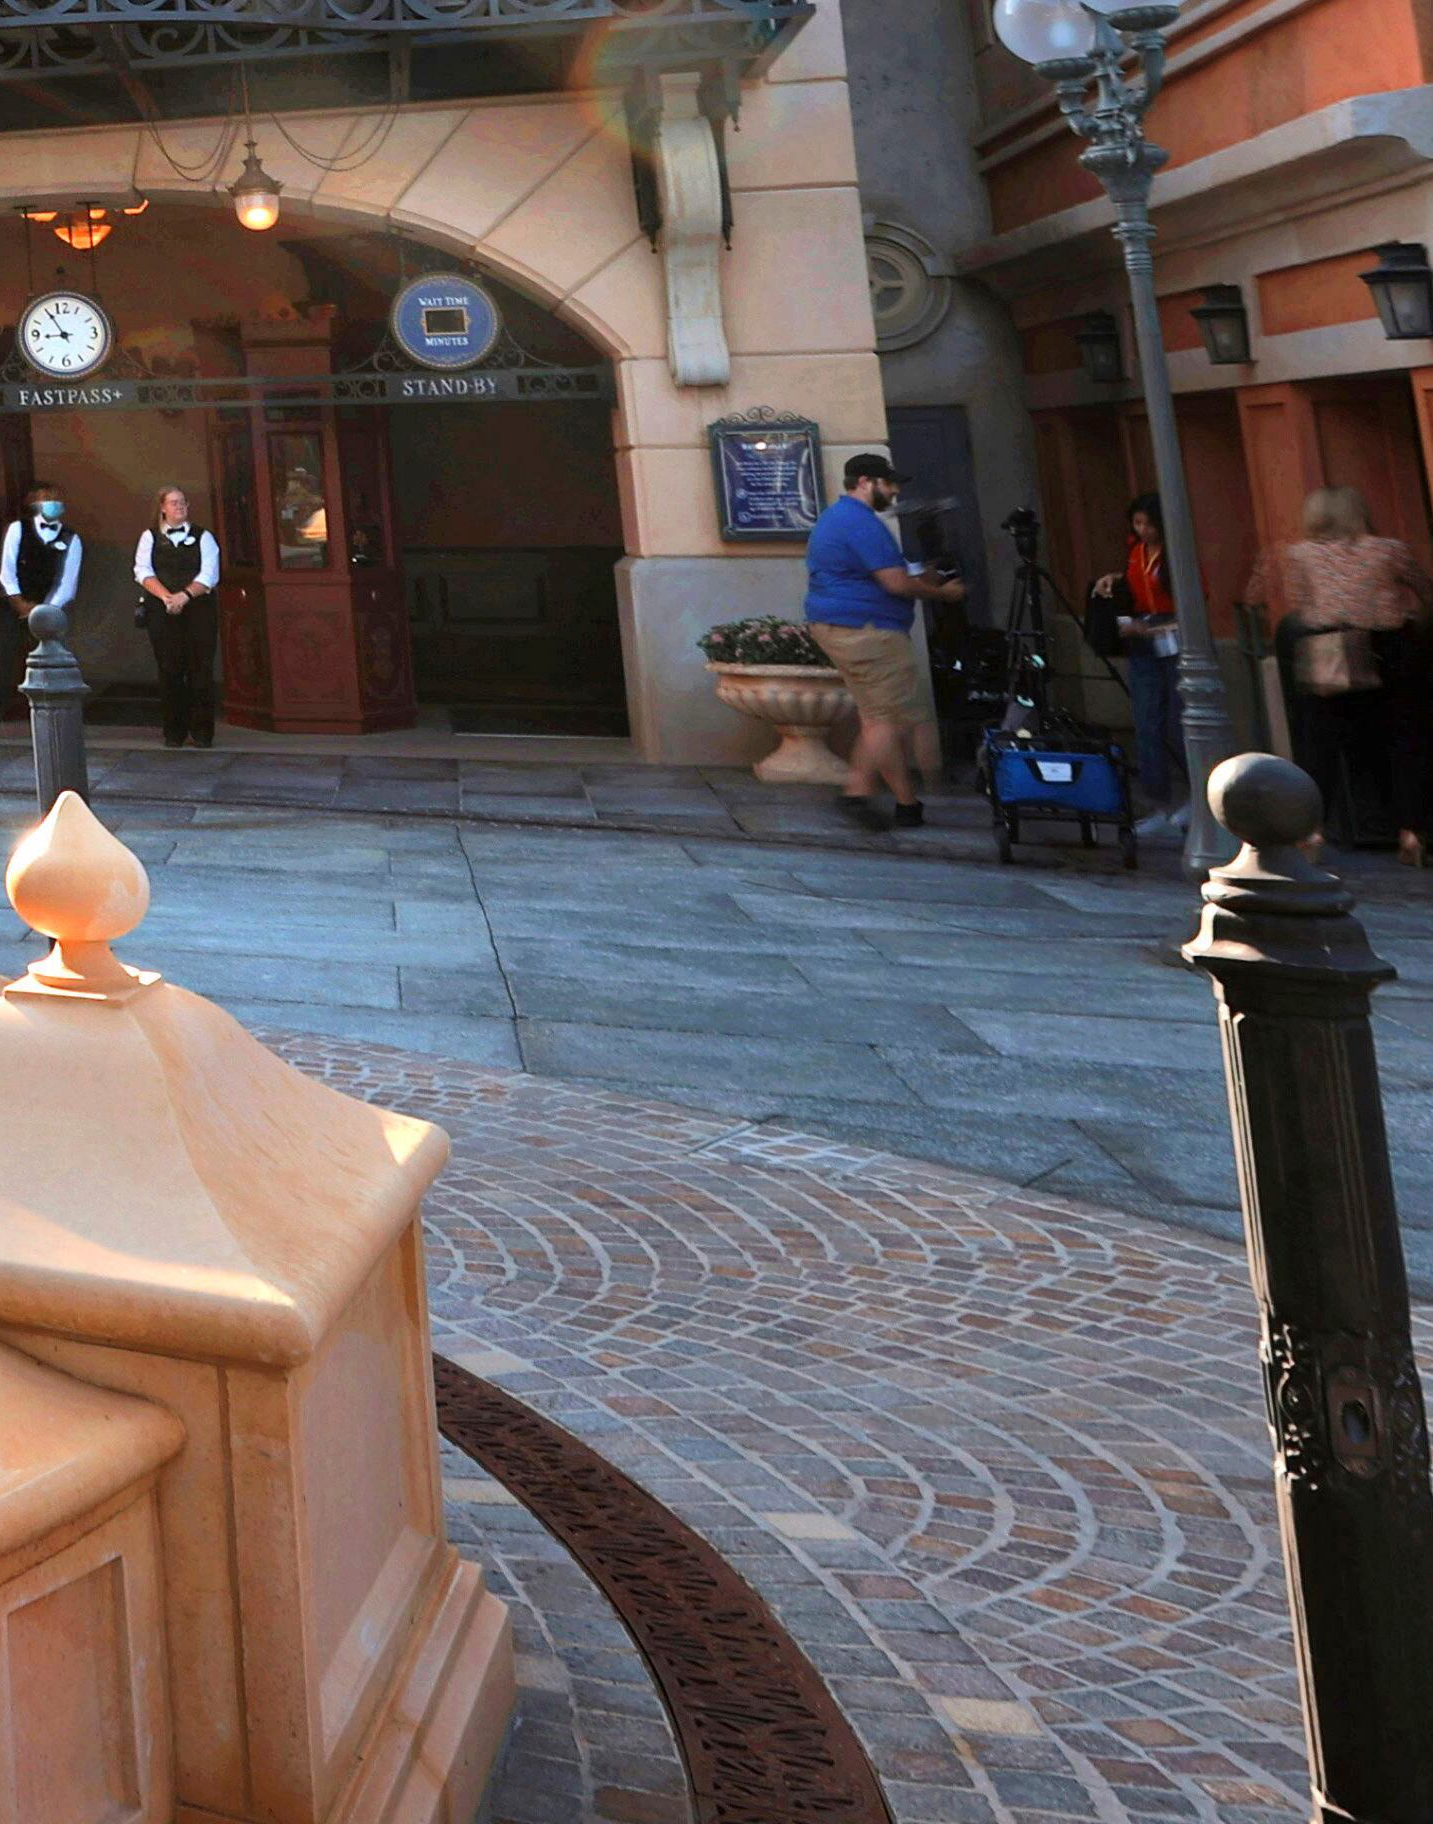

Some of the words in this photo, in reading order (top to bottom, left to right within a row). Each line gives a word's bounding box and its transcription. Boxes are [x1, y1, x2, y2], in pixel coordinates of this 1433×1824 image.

[54, 302, 71, 315] 12
[31, 329, 41, 342] 9
[89, 326, 99, 339] 3
[425, 336, 469, 346] MINUTES
[61, 354, 72, 368] 6
